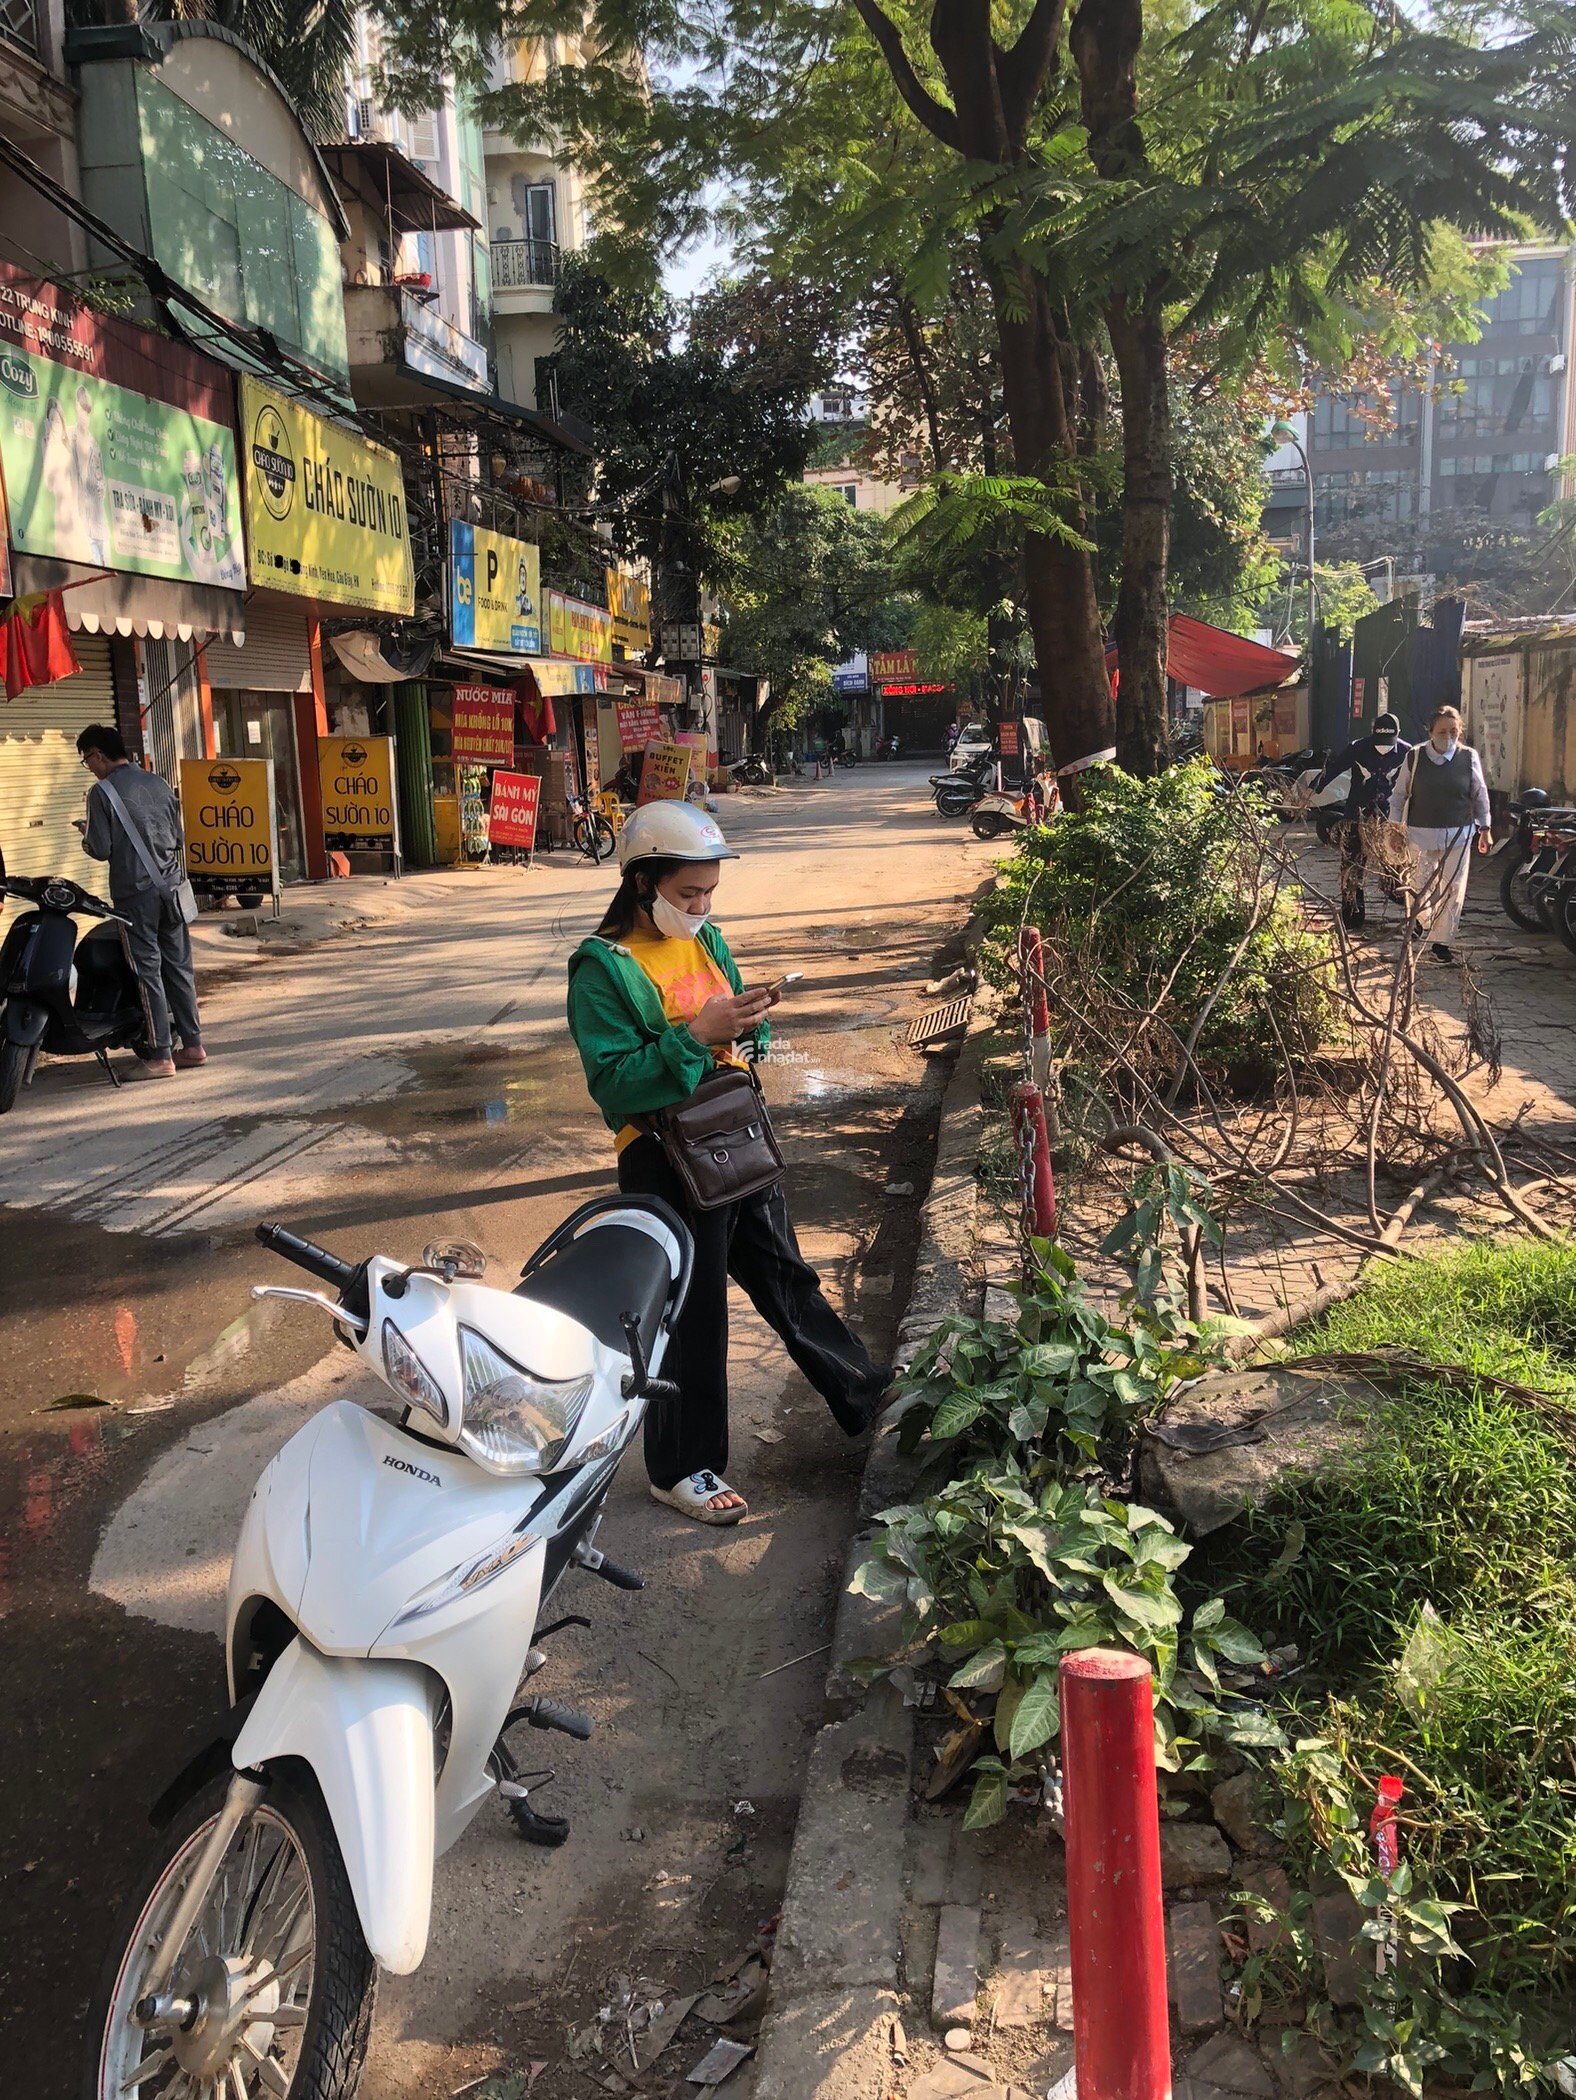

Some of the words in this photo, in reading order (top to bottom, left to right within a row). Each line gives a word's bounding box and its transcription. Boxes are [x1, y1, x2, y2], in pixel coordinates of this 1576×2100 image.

[14, 290, 49, 320] TRUNG
[1, 359, 33, 393] Cozy
[303, 457, 345, 521] CHÁO
[347, 474, 387, 535] SƯỜN
[388, 493, 402, 540] 10
[487, 549, 498, 592] P
[456, 564, 472, 605] be
[478, 597, 490, 611] FOOD
[494, 600, 508, 613] DRINK
[874, 654, 895, 675] TẮM
[897, 655, 910, 674] LÁ
[456, 687, 489, 702] NƯỚC
[491, 689, 512, 705] MÍA
[455, 711, 467, 728] MÍA
[649, 752, 684, 765] BUFFET
[334, 771, 378, 795] CHÁO
[495, 780, 520, 800] BÁNH
[200, 800, 254, 829] CHÁO
[326, 801, 370, 825] SƯỜN
[374, 807, 390, 825] 10
[493, 802, 509, 822] SÀI
[511, 806, 533, 826] GÒN
[190, 836, 244, 865] SƯỜN
[250, 843, 269, 865] 10
[381, 1455, 442, 1488] HONDA
